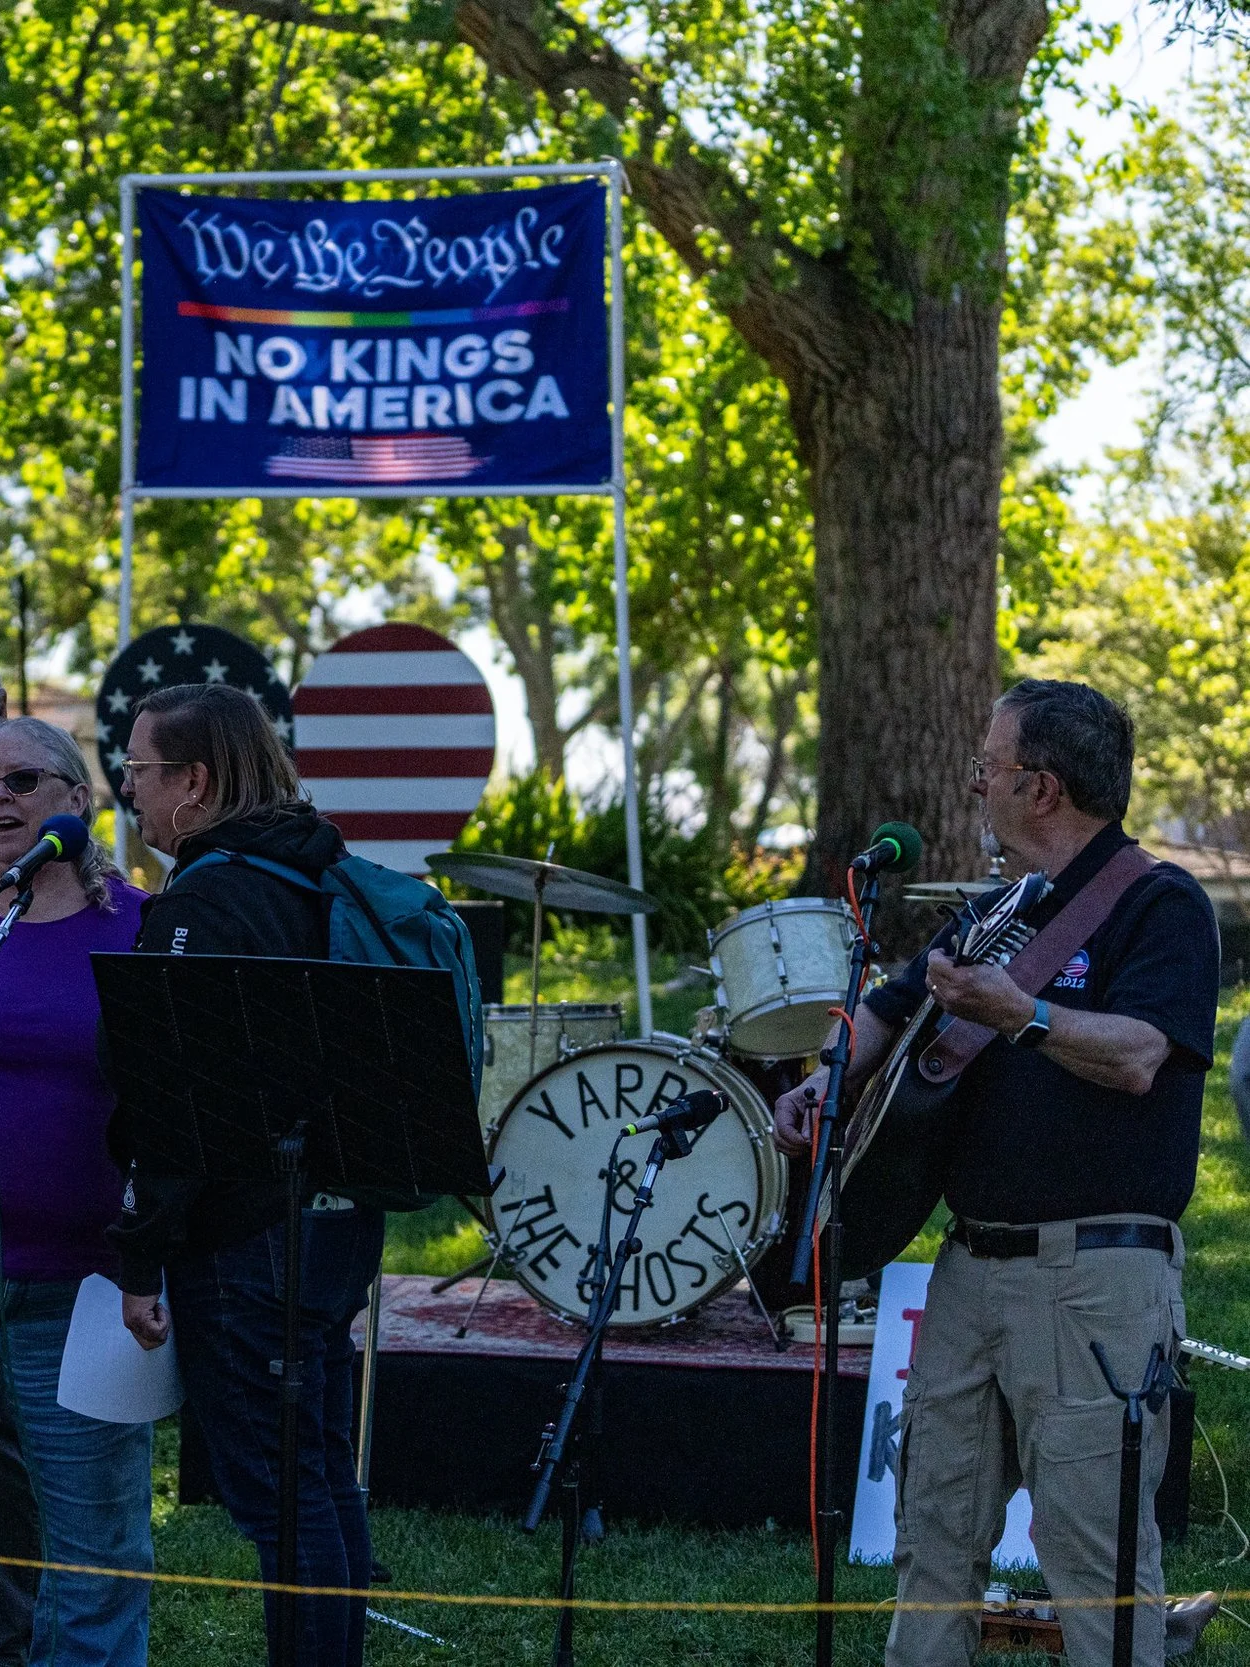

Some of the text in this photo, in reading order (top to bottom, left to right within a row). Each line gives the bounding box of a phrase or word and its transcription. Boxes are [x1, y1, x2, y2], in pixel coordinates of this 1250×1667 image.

[179, 208, 289, 289] We
[363, 206, 565, 304] People
[214, 329, 535, 383] NO KINGS
[178, 374, 570, 430] IN AMERICA
[1054, 976, 1085, 988] 2012
[612, 1158, 654, 1217] &
[500, 1184, 582, 1281] THE
